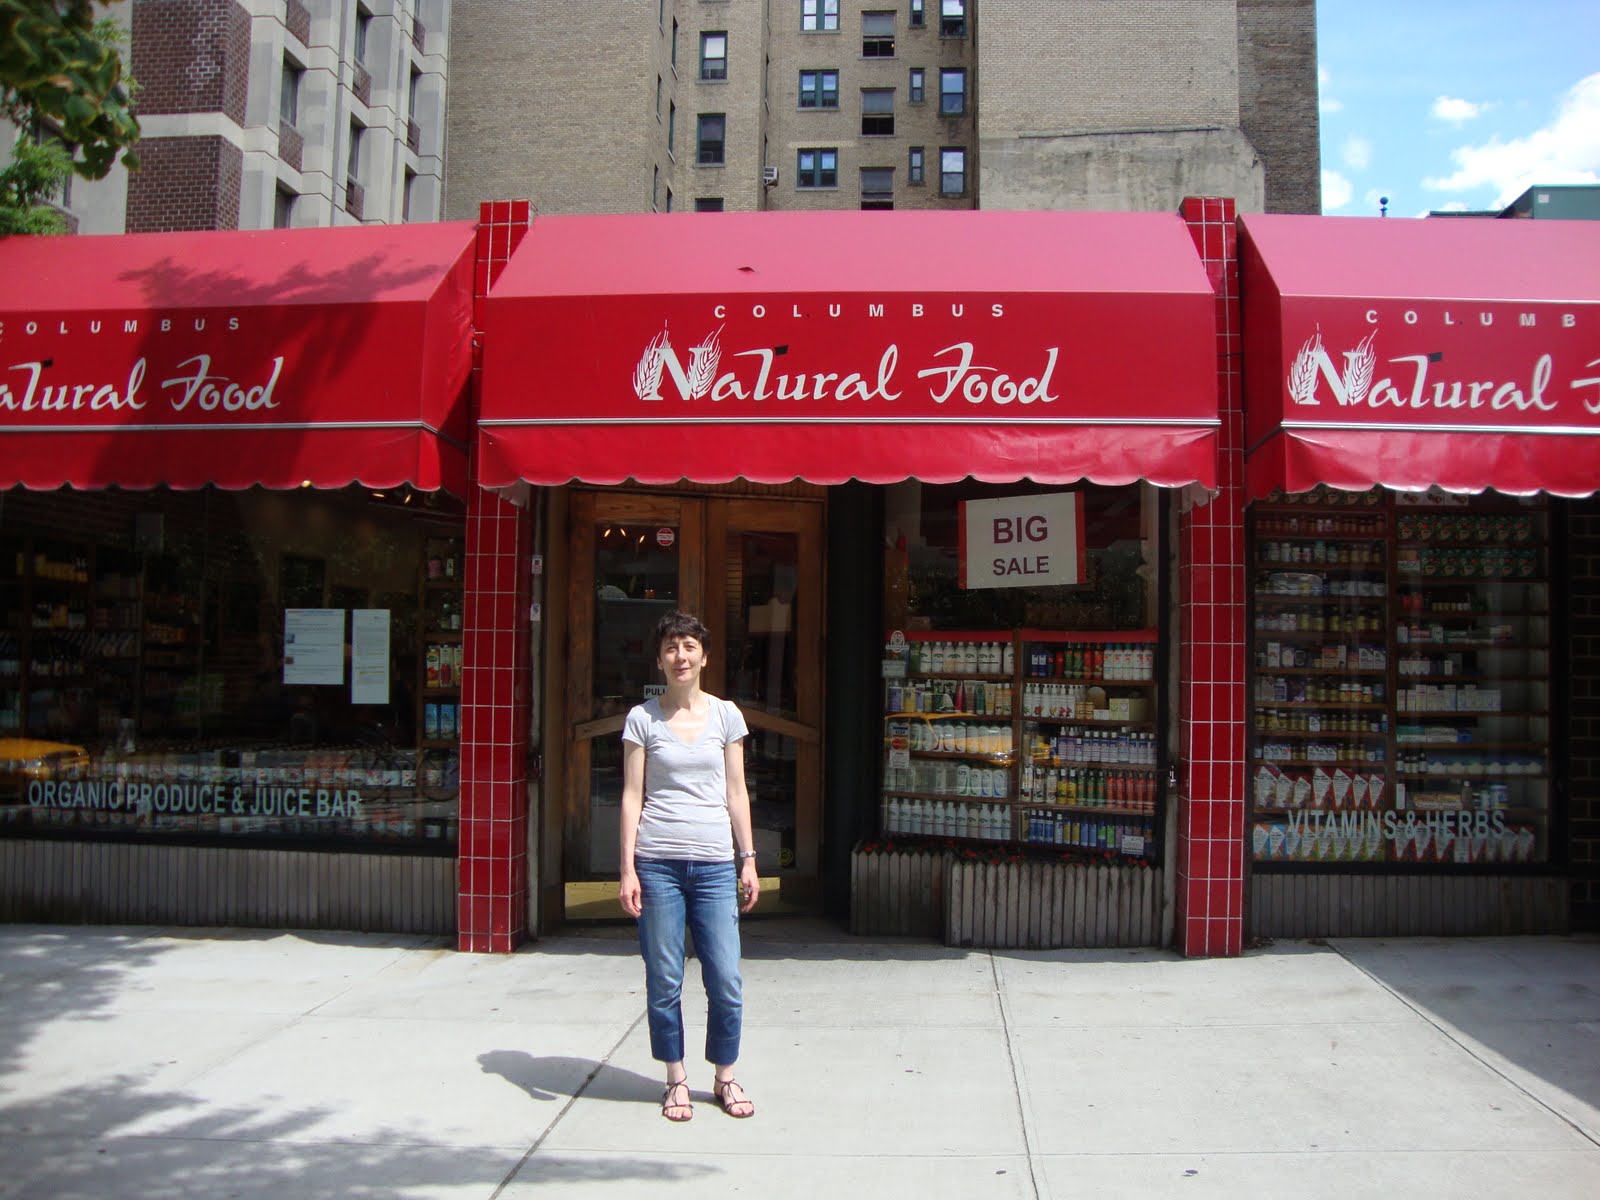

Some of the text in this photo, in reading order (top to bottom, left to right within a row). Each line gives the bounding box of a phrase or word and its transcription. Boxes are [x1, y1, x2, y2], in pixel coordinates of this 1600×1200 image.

[713, 303, 1004, 319] COLUMBUS
[161, 353, 284, 412] Food
[632, 328, 1060, 405] Natural Food
[1287, 333, 1559, 412] Natural
[993, 515, 1048, 544] BIG
[992, 555, 1050, 576] SALE
[28, 780, 362, 818] ORGANIC PRODUCE & JUICE BAR
[1287, 809, 1505, 841] VITAMINS & HERBS
